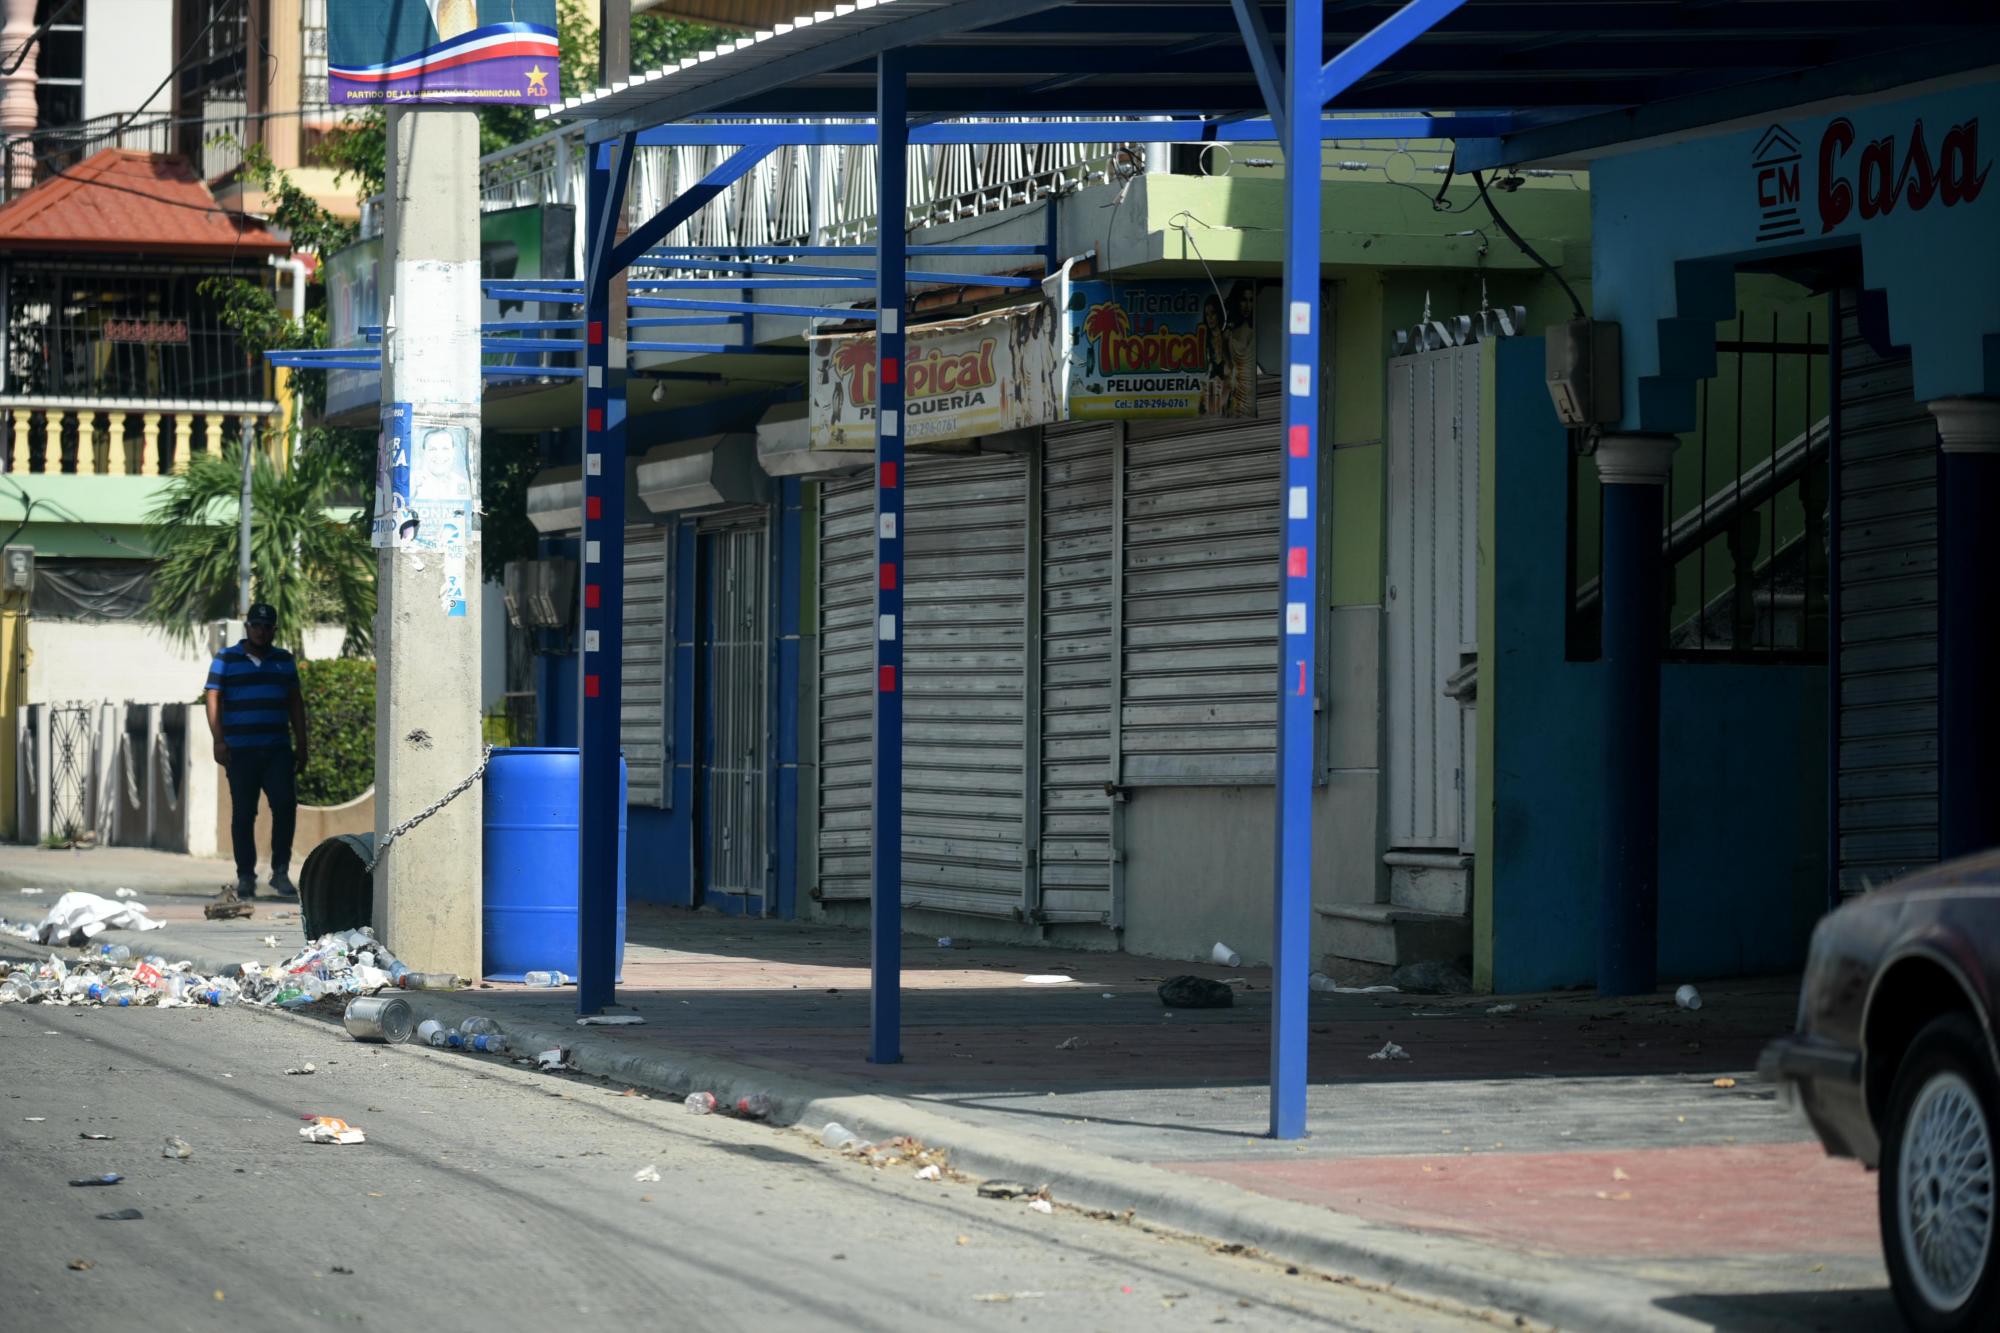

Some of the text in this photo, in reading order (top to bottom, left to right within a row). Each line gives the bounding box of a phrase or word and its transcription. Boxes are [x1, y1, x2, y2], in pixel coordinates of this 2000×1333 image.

[346, 90, 384, 99] PARTIDO
[386, 90, 398, 98] DE
[527, 87, 548, 97] PLD
[1758, 163, 1800, 208] CM
[1125, 290, 1199, 313] Tienda
[1084, 302, 1209, 376] Tropical
[832, 337, 997, 407] Trpical
[1107, 376, 1201, 393] PELUQUERÍA
[859, 391, 986, 420] PEQUERÍA
[1133, 398, 1189, 409] 829-296-0761
